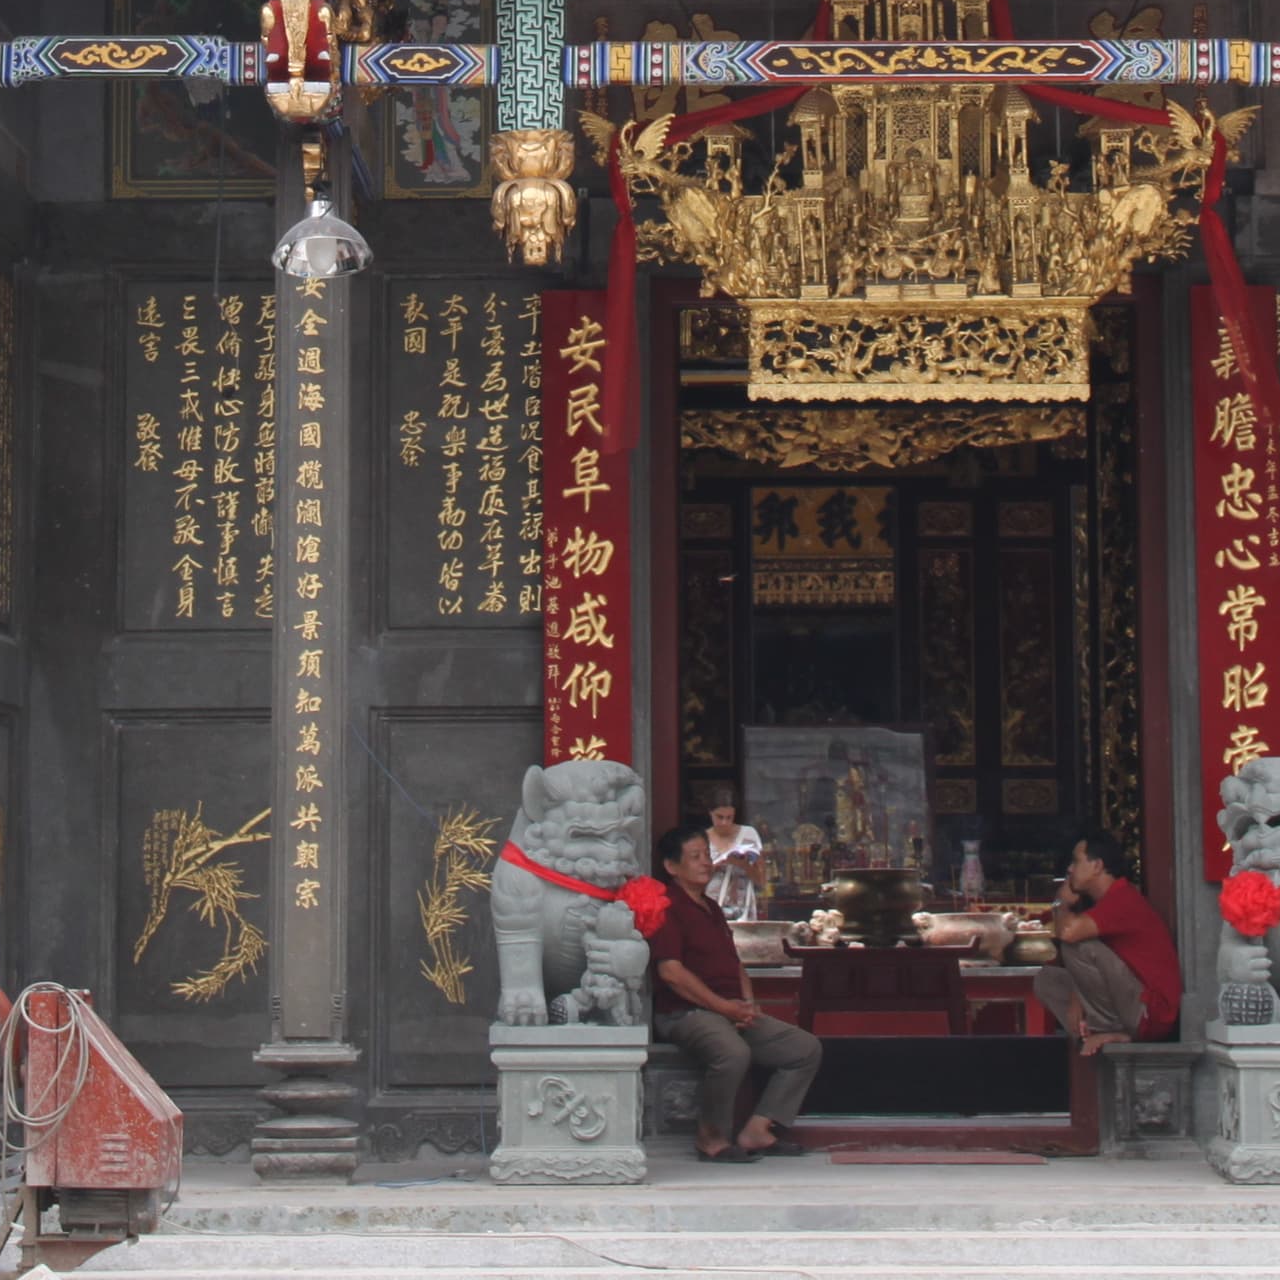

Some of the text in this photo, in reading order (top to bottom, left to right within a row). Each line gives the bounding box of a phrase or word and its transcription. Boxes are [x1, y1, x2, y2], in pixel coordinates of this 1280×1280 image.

[1209, 314, 1270, 776] 義膽忠心常昭帝
